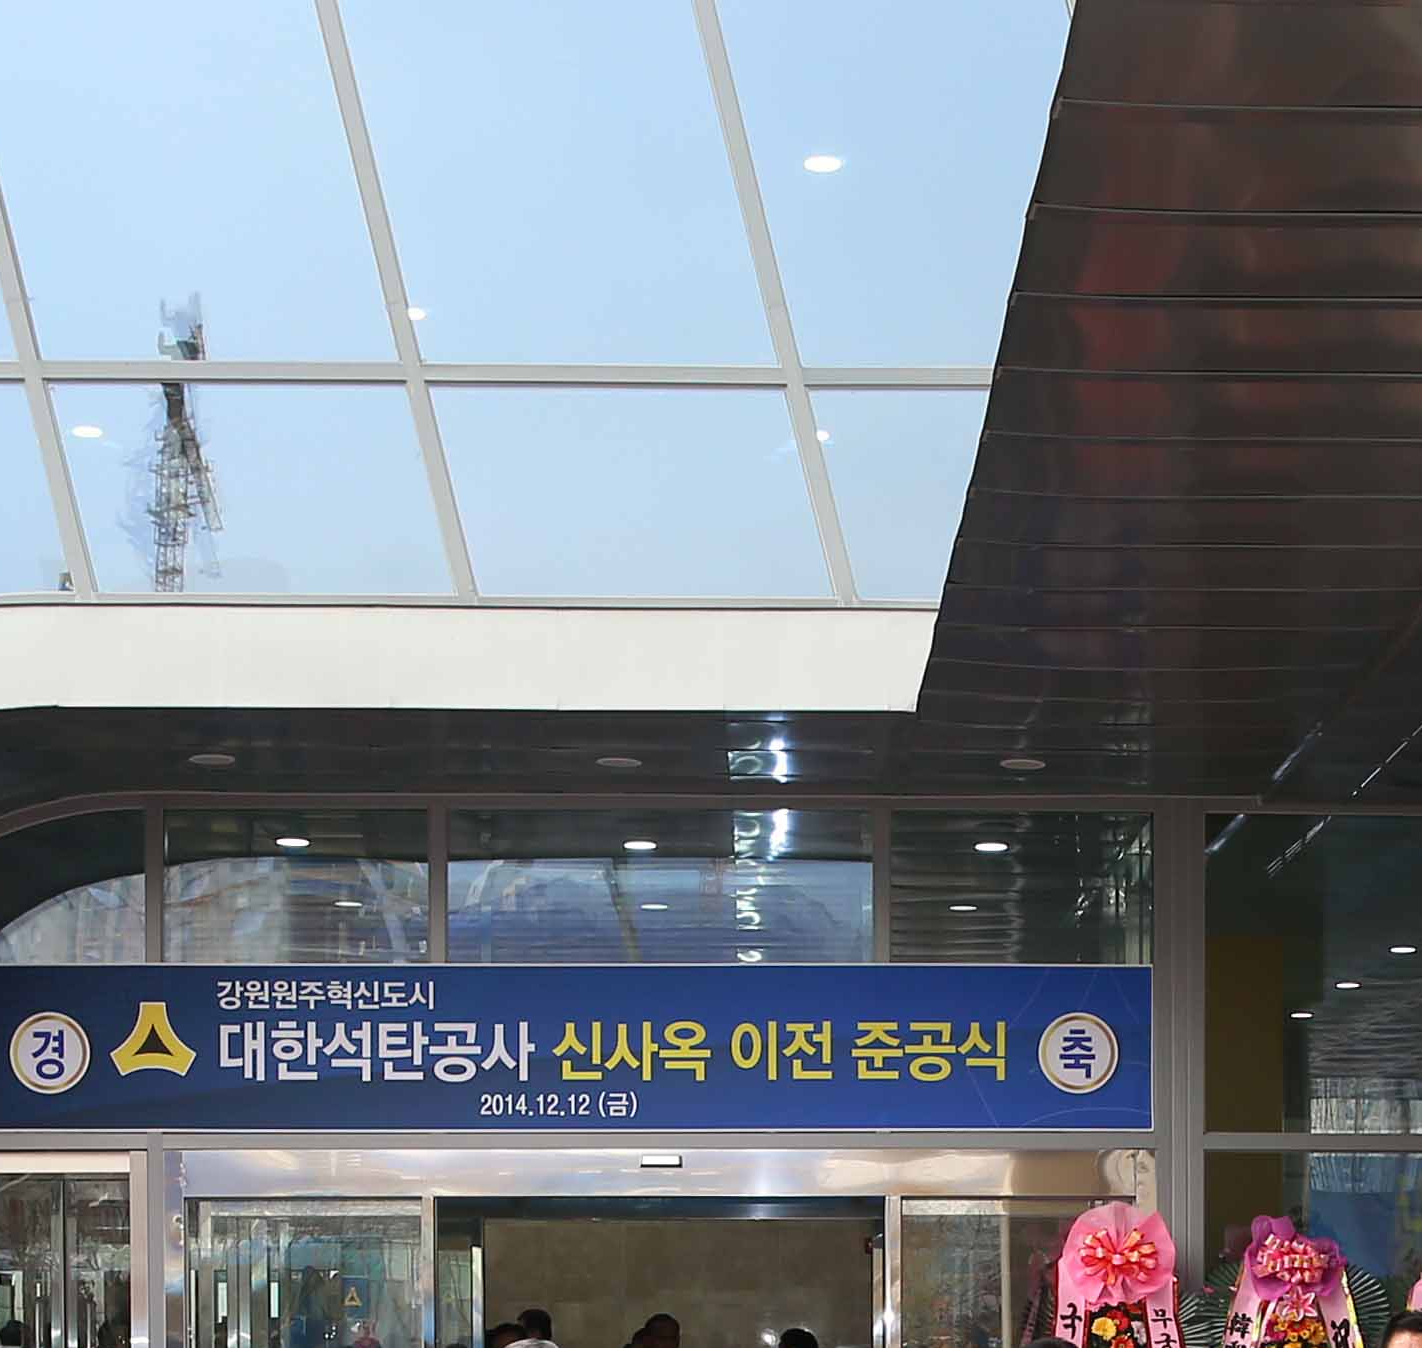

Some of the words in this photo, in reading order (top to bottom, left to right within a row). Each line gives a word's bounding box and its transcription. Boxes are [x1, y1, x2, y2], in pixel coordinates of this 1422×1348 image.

[216, 980, 435, 1010] 강원원주혁신도시
[31, 1028, 68, 1081] 경
[219, 1020, 536, 1082] 대한석탄공사
[552, 1020, 712, 1081] 신사옥
[730, 1020, 834, 1080] 이전
[851, 1020, 1007, 1082] 준공식
[1059, 1029, 1096, 1079] 축
[480, 1092, 591, 1117] 2014.12.12
[598, 1091, 639, 1118] (금)
